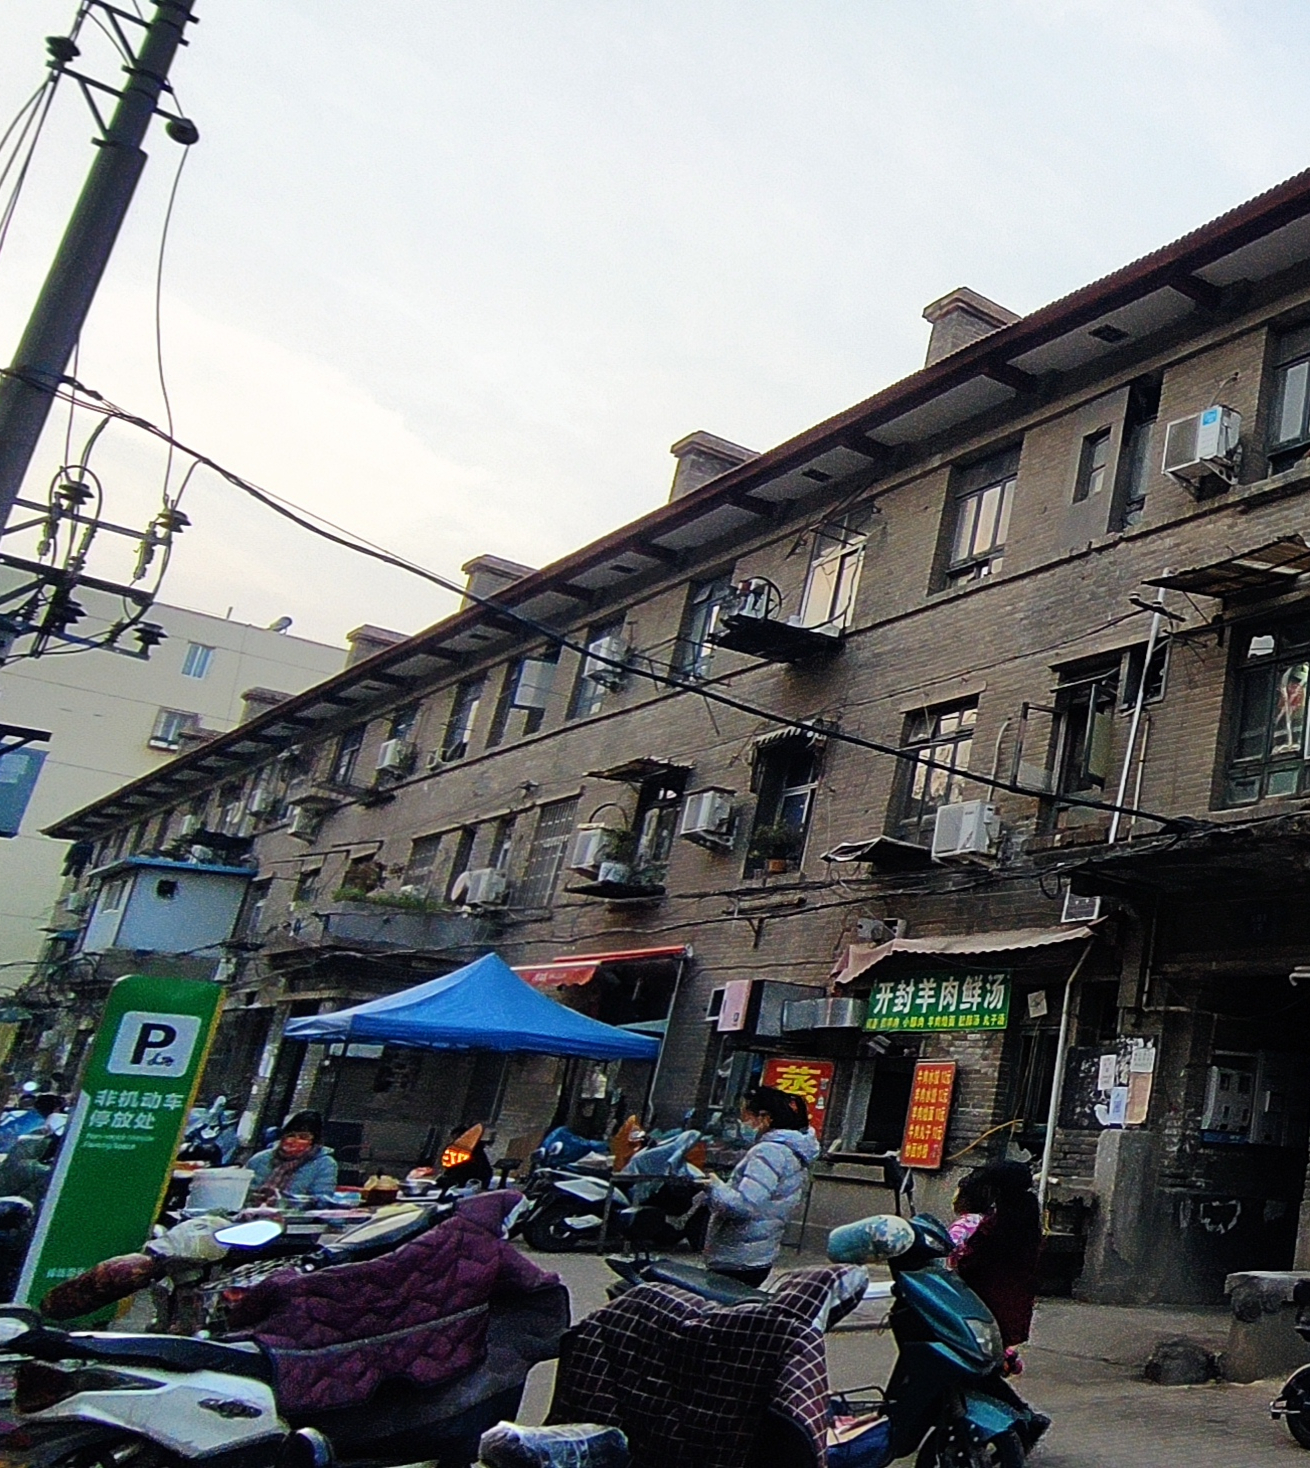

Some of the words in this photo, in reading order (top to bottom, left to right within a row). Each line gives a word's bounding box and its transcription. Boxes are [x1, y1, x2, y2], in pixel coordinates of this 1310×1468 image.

[873, 973, 1006, 1015] 开封羊肉鲜汤
[130, 1022, 177, 1065] P
[94, 1089, 185, 1110] 非机动车
[88, 1110, 156, 1129] 停放处
